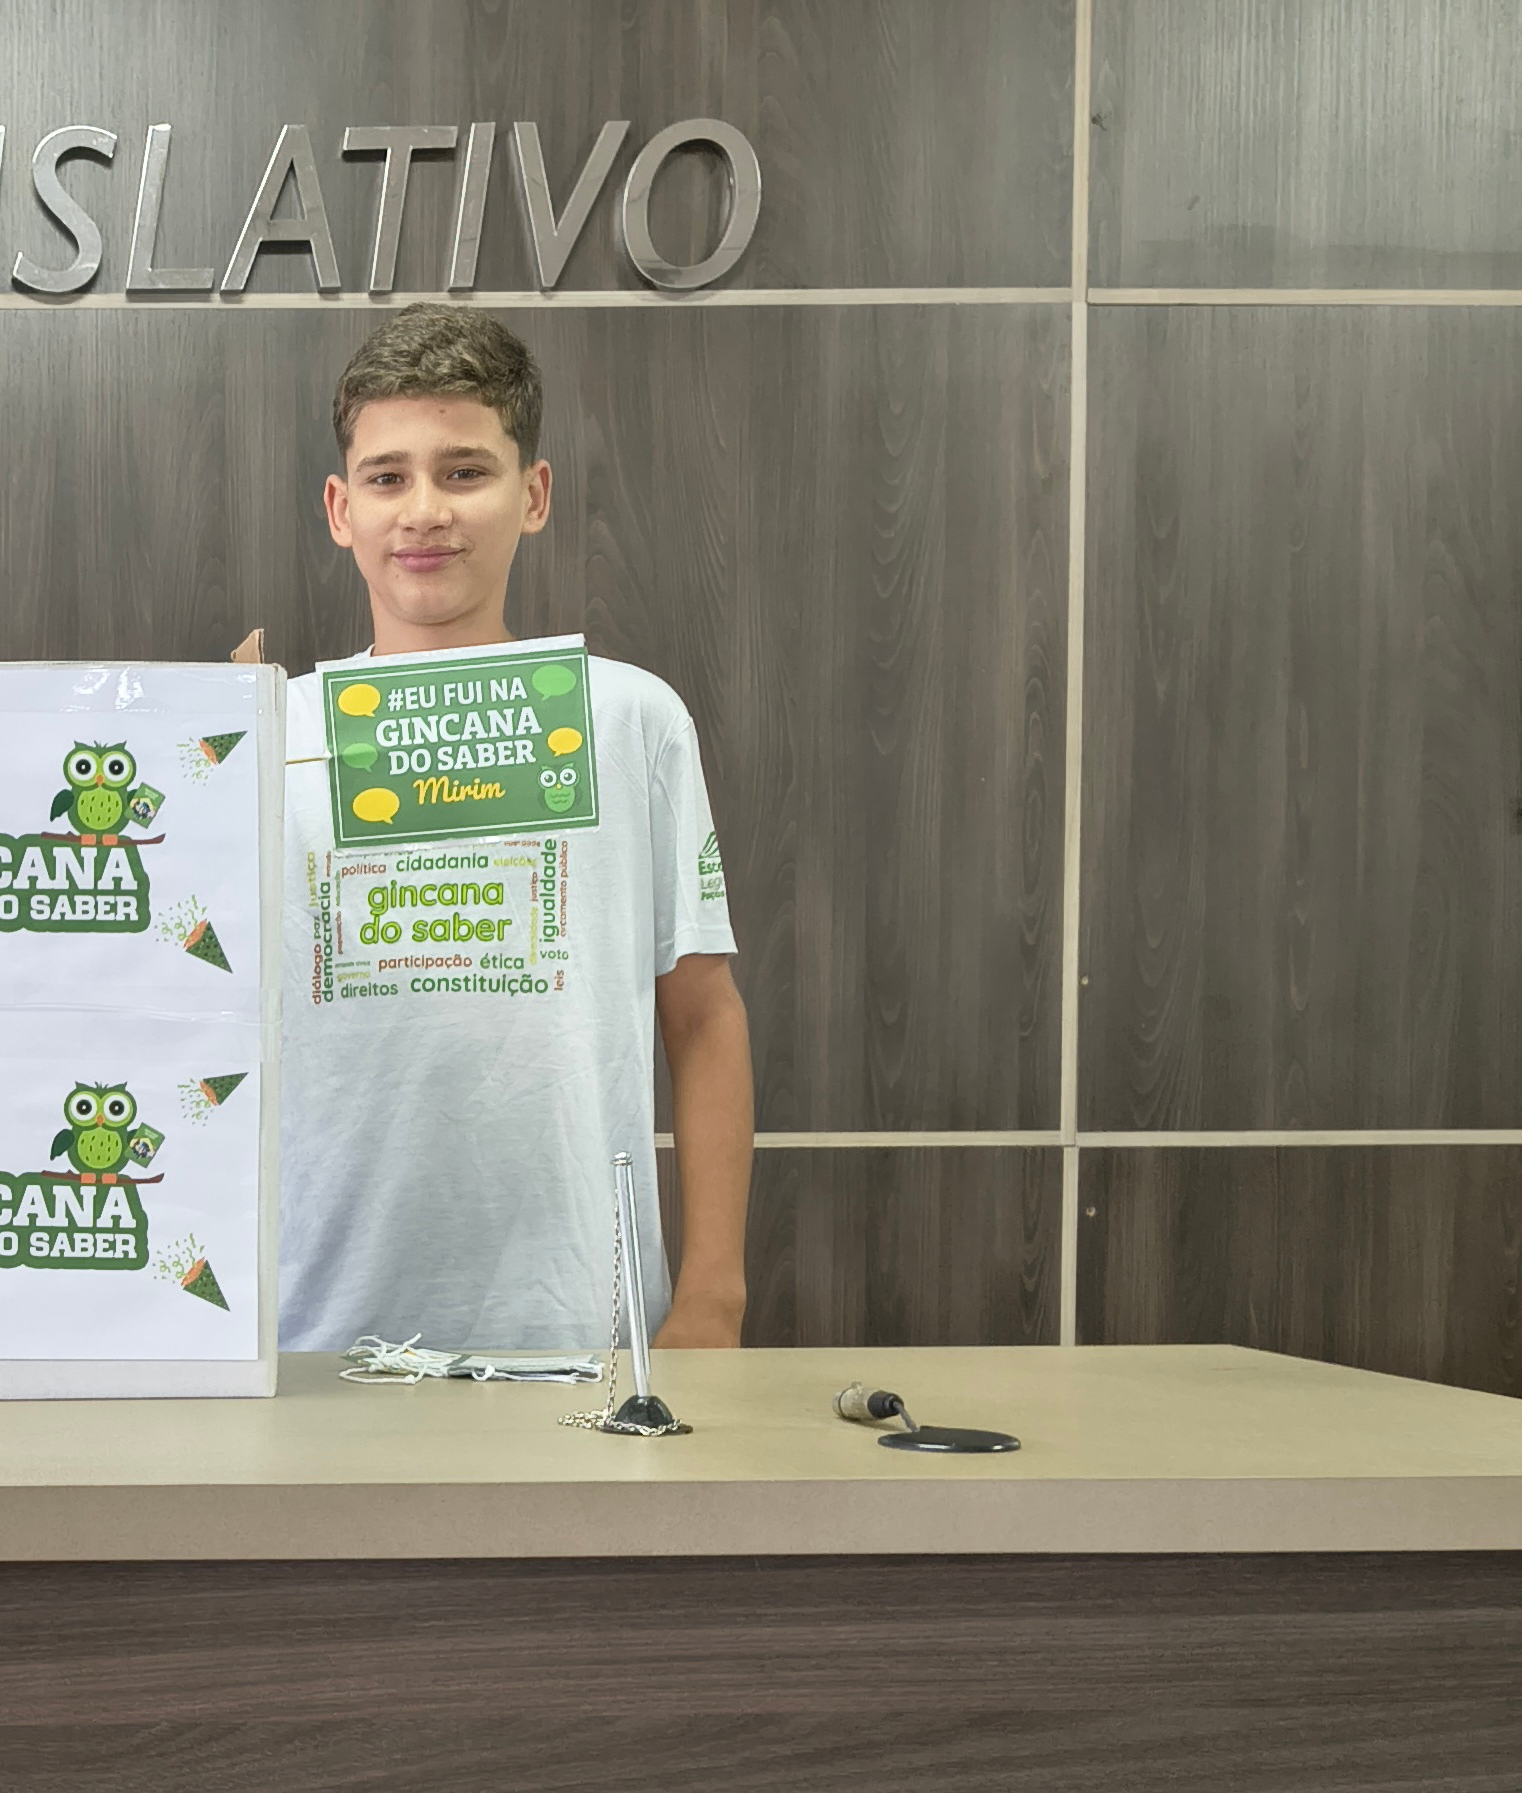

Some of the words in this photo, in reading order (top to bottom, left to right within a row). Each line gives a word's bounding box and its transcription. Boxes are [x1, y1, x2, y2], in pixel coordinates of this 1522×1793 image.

[387, 683, 437, 712] #EU
[443, 680, 484, 710] FUI
[489, 676, 527, 702] NA
[376, 706, 542, 749] GINCANA
[388, 749, 432, 776] DO
[436, 739, 537, 771] SABER
[413, 776, 506, 806] Mirim
[341, 863, 387, 879] política
[396, 852, 489, 872] cidadania
[367, 879, 504, 916] gincana
[539, 838, 560, 943] igualdade
[29, 894, 138, 922] SABER
[318, 882, 333, 1003] democracia
[359, 914, 402, 944] do
[411, 911, 513, 943] saber
[378, 954, 472, 972] participação
[480, 952, 524, 970] ética
[540, 949, 569, 960] voto
[340, 982, 399, 999] direitos
[410, 973, 549, 997] constituição
[29, 1232, 137, 1259] SABER
